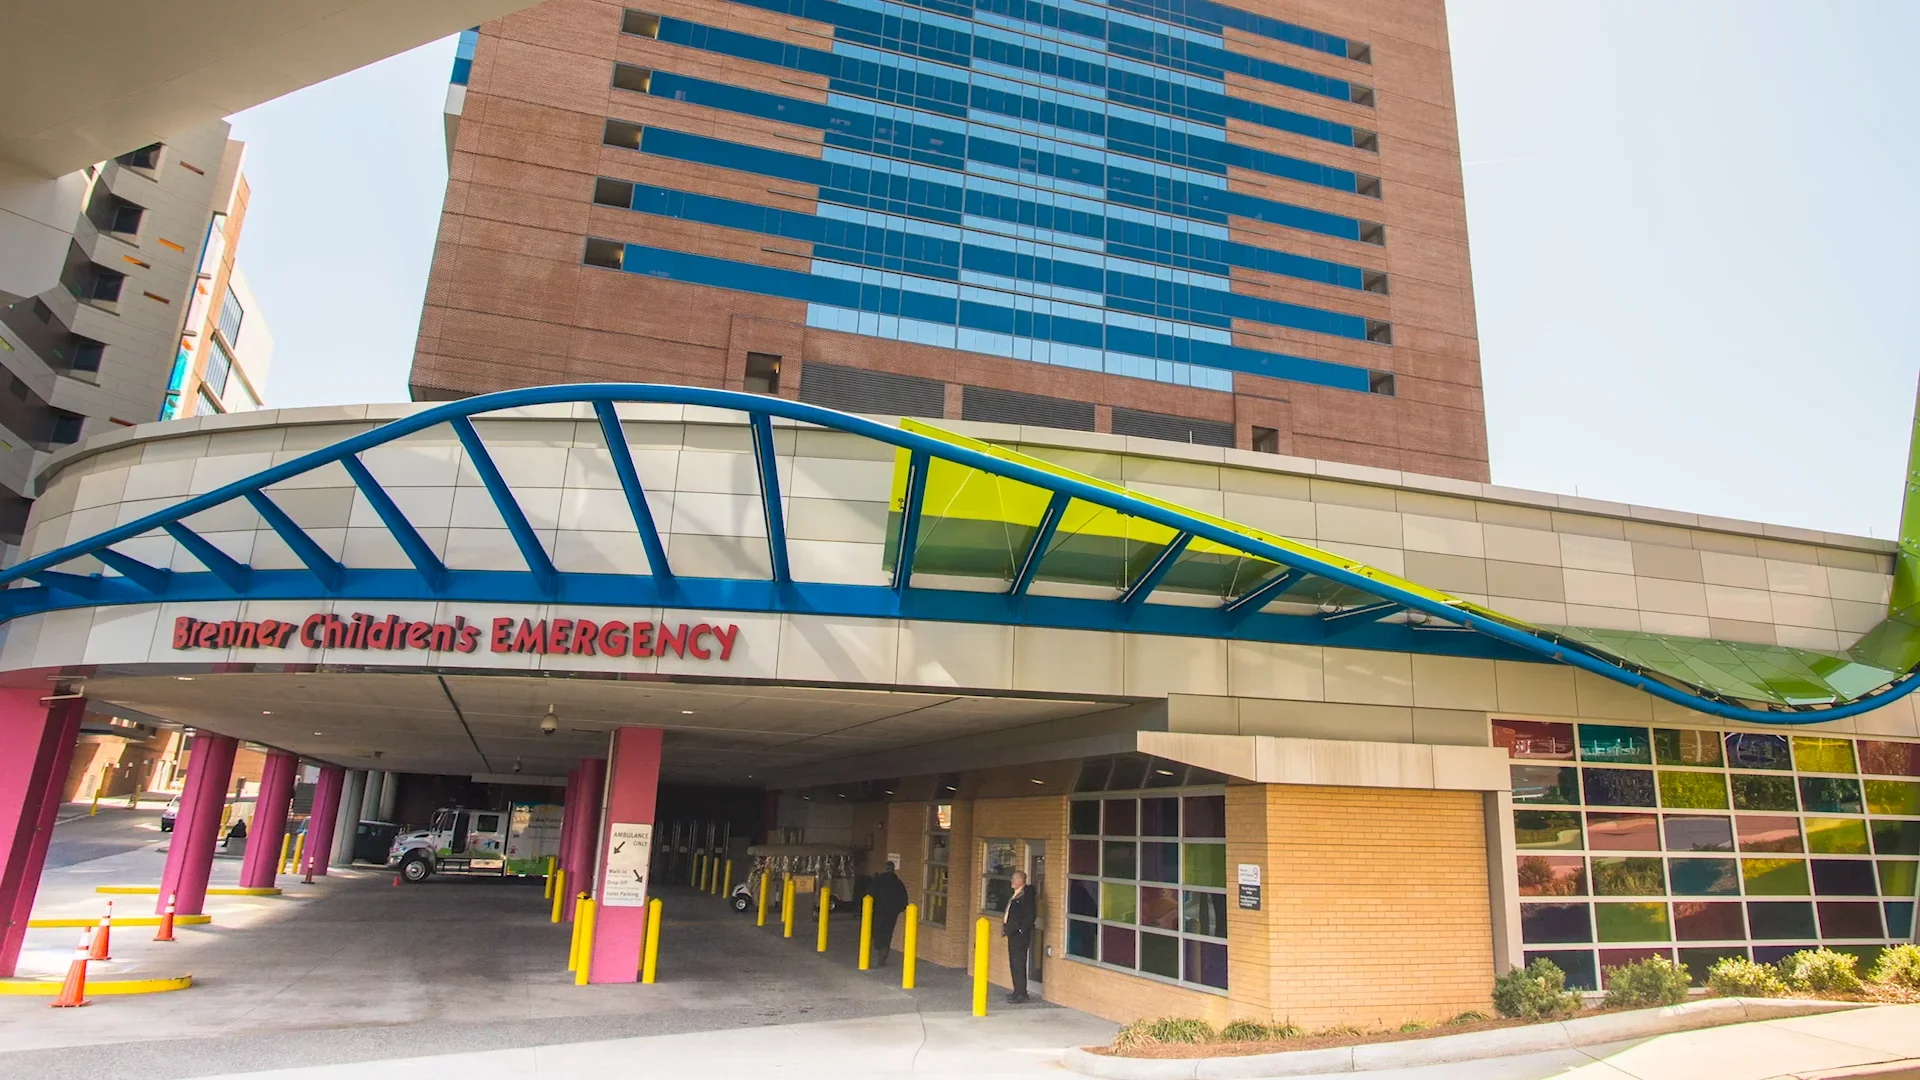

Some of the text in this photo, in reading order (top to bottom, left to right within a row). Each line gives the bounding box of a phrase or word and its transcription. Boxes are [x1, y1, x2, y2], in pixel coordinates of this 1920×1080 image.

[172, 612, 738, 661] Brenner Children's EMERGENCY
